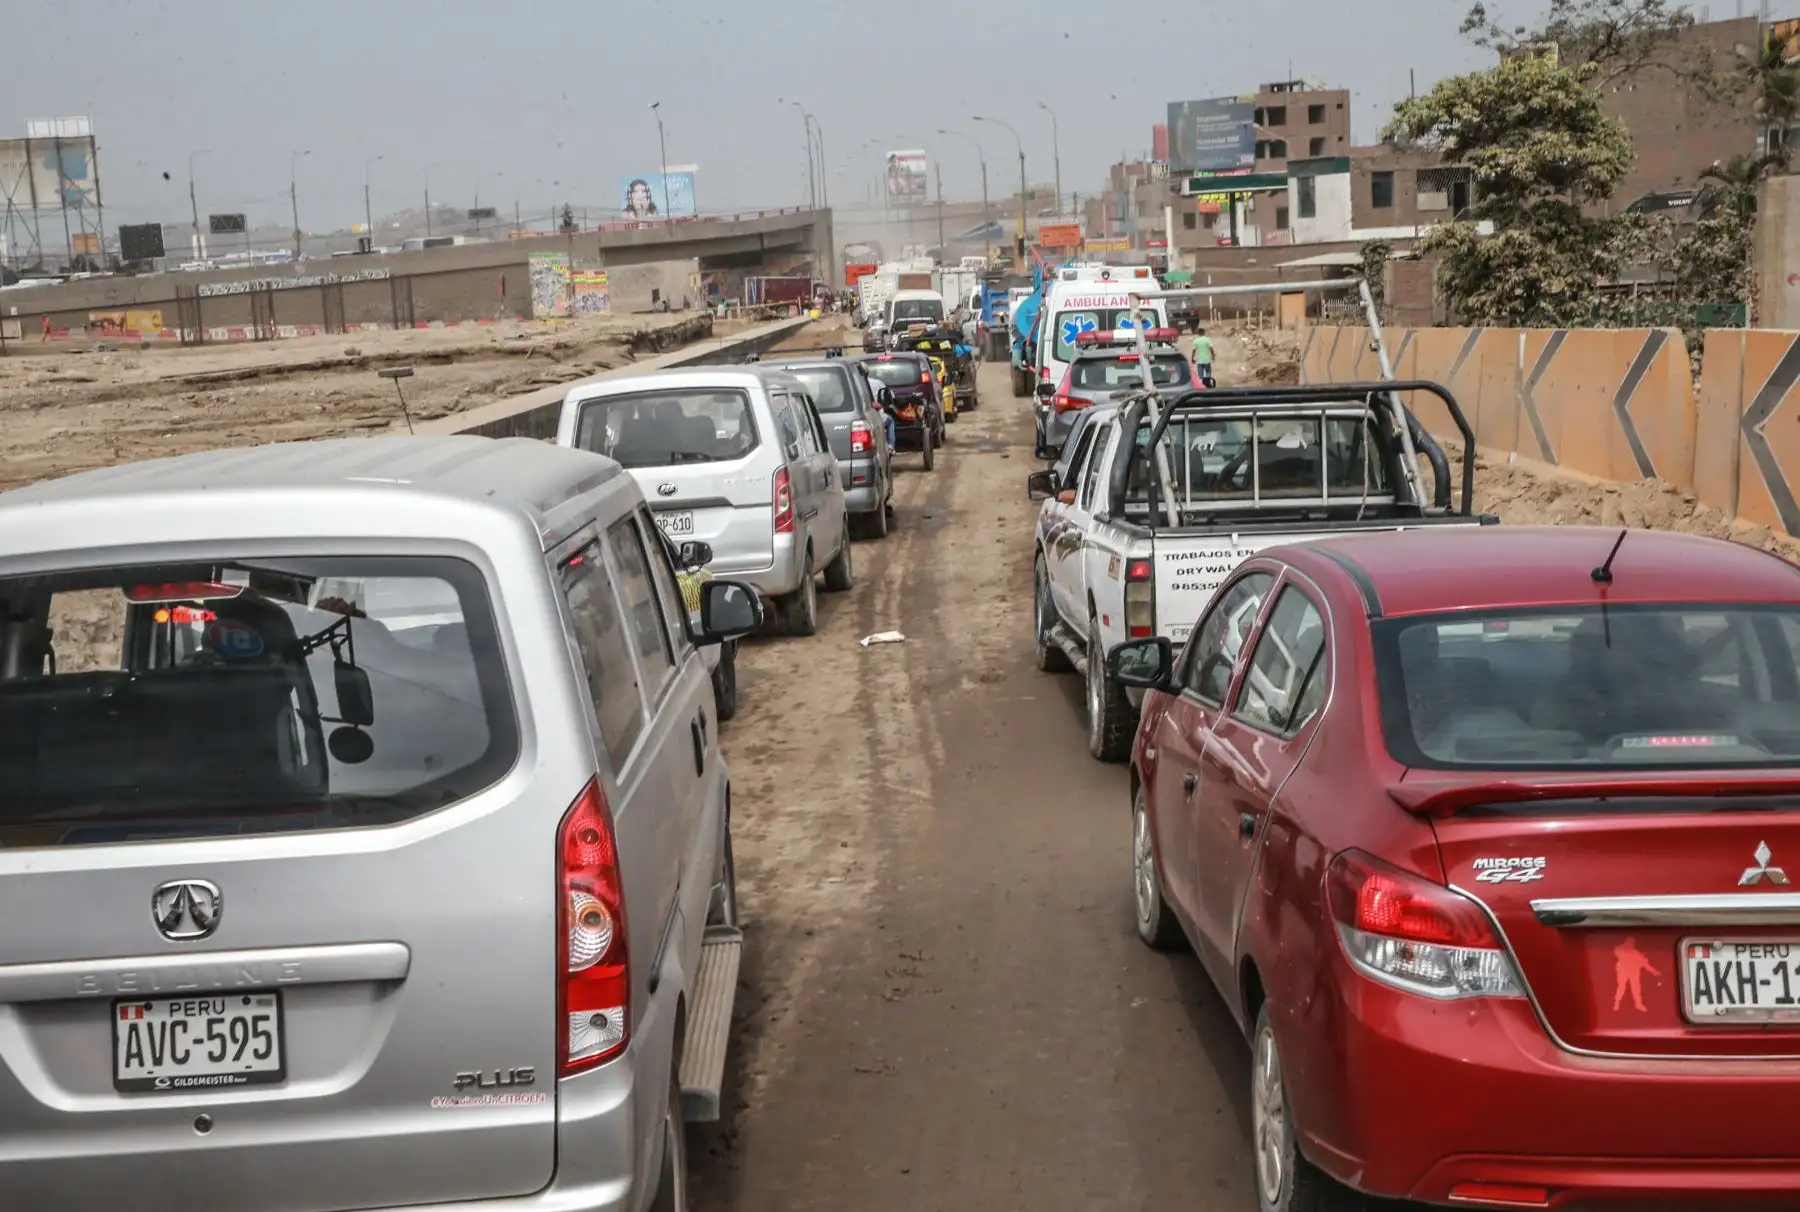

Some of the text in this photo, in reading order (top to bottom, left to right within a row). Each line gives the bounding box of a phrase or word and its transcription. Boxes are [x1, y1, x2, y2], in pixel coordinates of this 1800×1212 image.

[1063, 296, 1152, 308] AMBULANA
[655, 516, 691, 532] P-610
[1163, 549, 1255, 561] TRABAJOS EN
[1176, 564, 1233, 576] DRYWAL
[1472, 856, 1546, 869] MIRAGE
[1475, 867, 1545, 884] G4
[1734, 944, 1790, 958] PERU
[1694, 960, 1800, 1005] AKH-1
[169, 999, 226, 1018] PERU
[124, 1014, 273, 1069] AVC-595
[173, 1075, 234, 1087] GILDEMEISTER
[453, 1066, 536, 1091] PLUS
